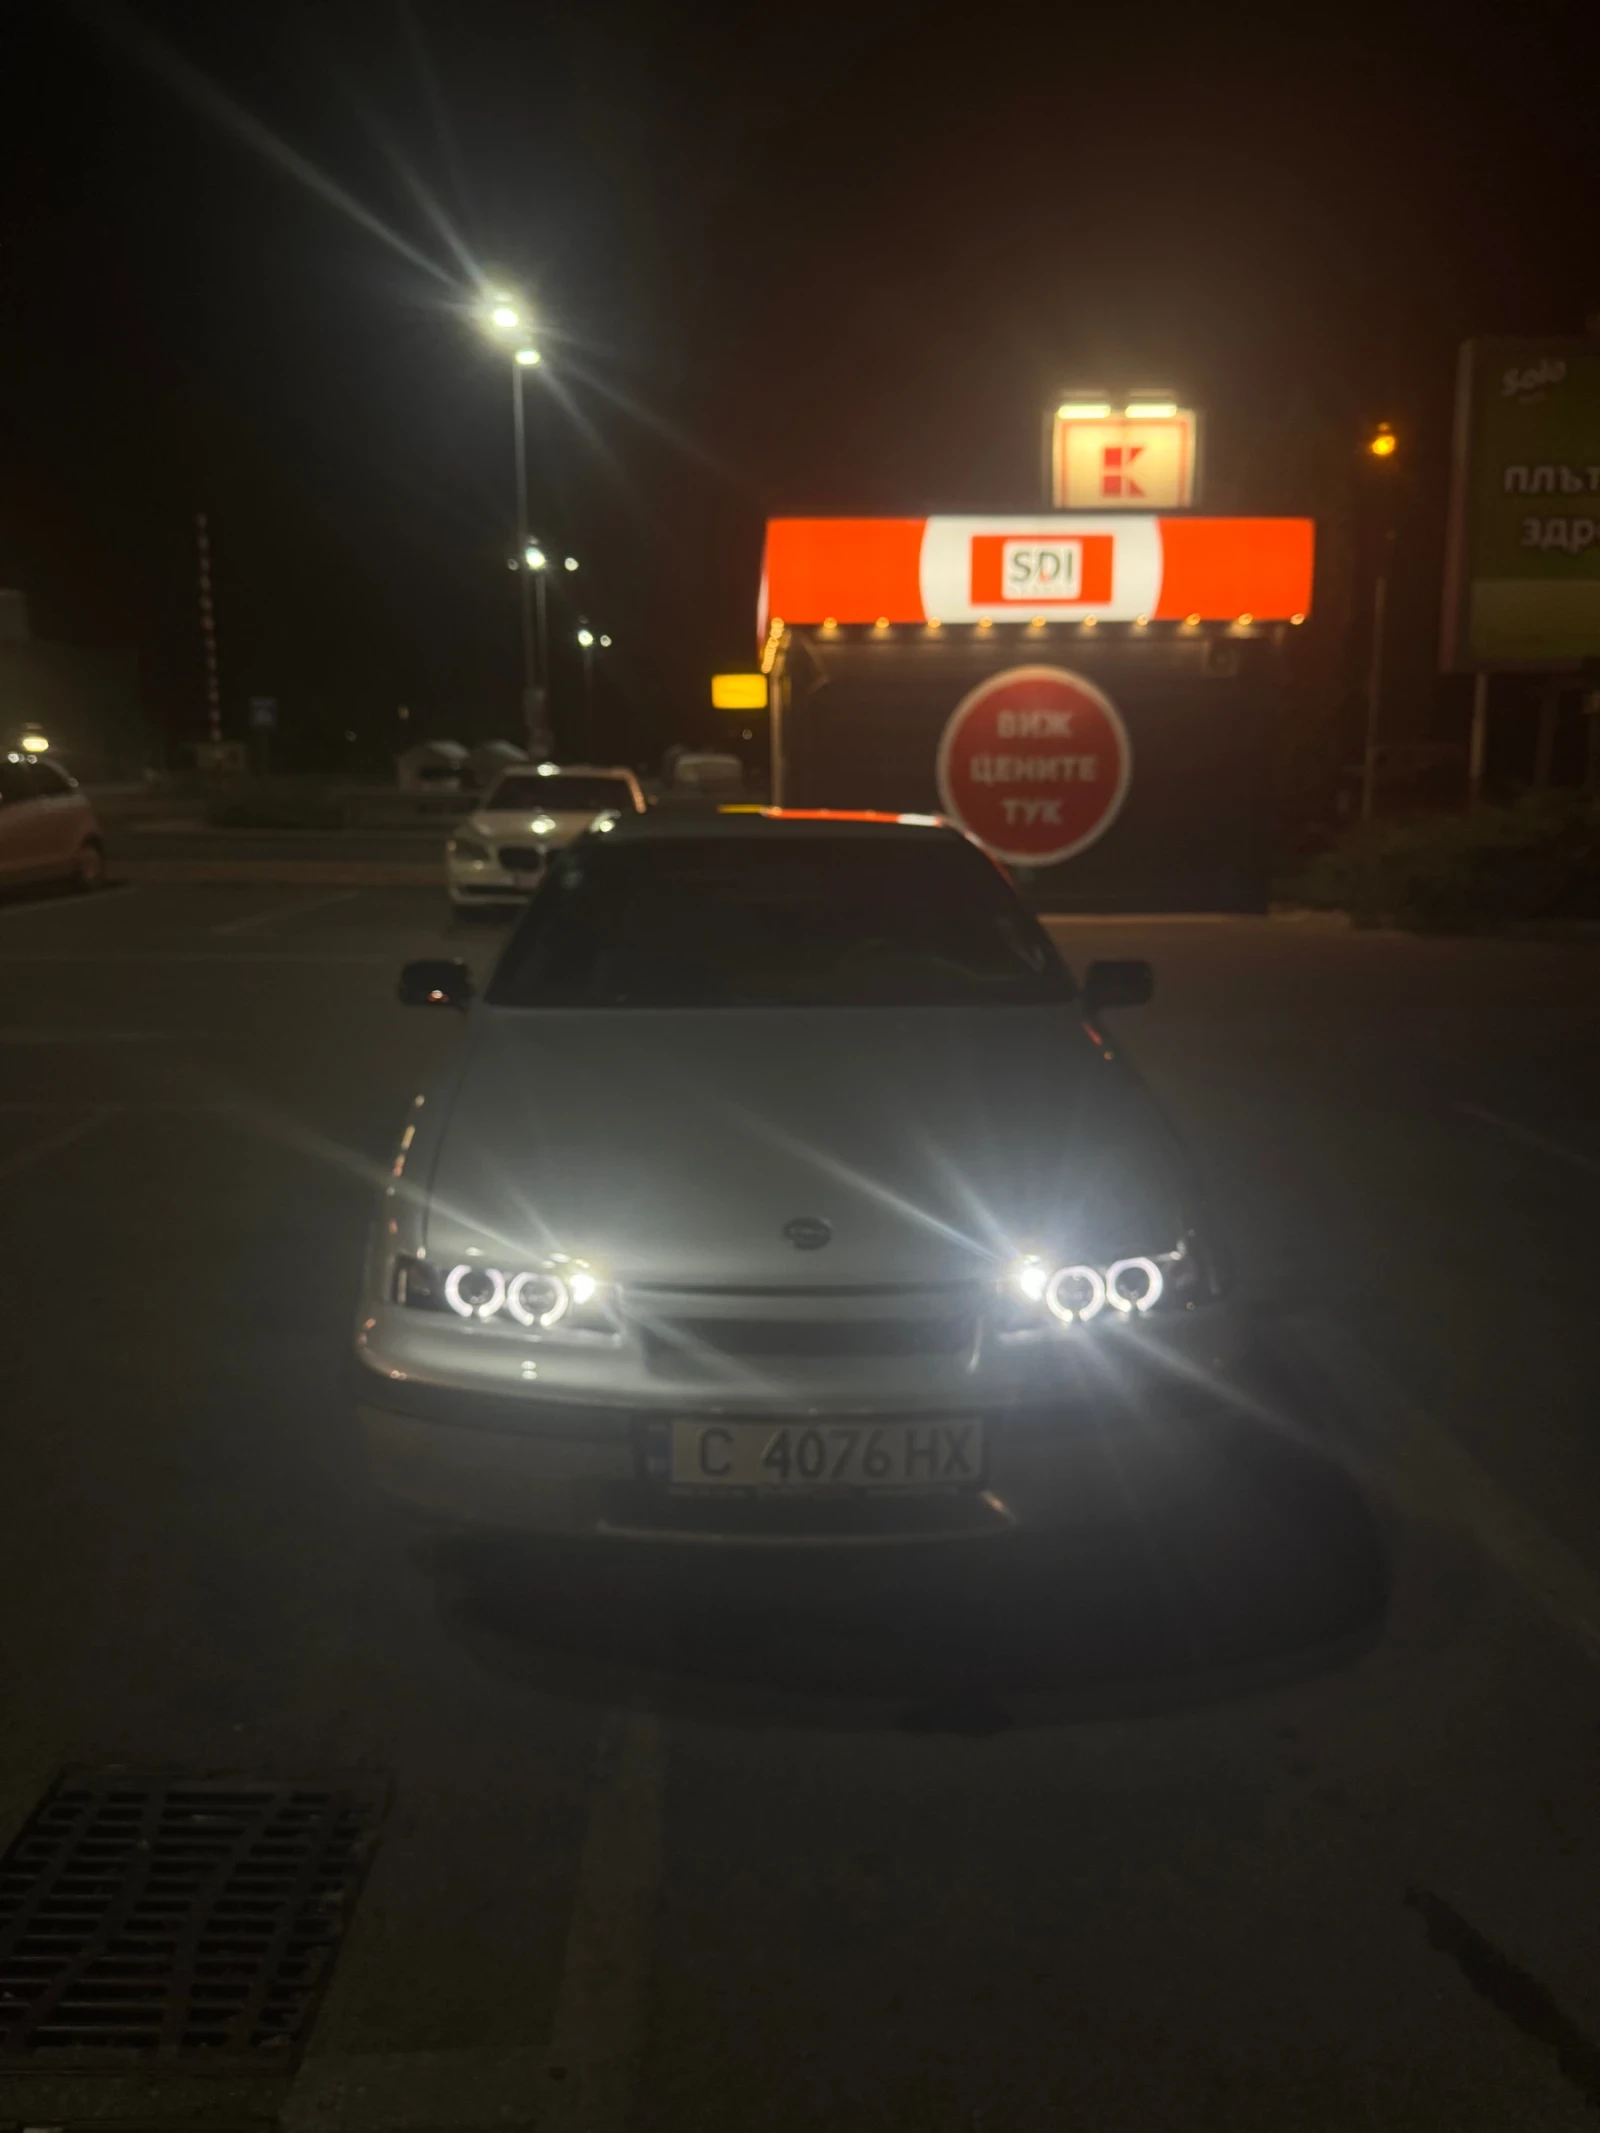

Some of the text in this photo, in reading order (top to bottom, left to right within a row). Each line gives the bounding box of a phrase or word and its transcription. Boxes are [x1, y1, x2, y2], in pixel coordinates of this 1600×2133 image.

[1103, 447, 1145, 497] K
[1520, 516, 1600, 555] здр
[1010, 551, 1073, 582] SDI
[997, 710, 1072, 739] ВИЖ
[969, 755, 1097, 788] ЦЕНИТЕ
[1002, 798, 1063, 826] ТУК
[761, 1428, 892, 1480] 4076
